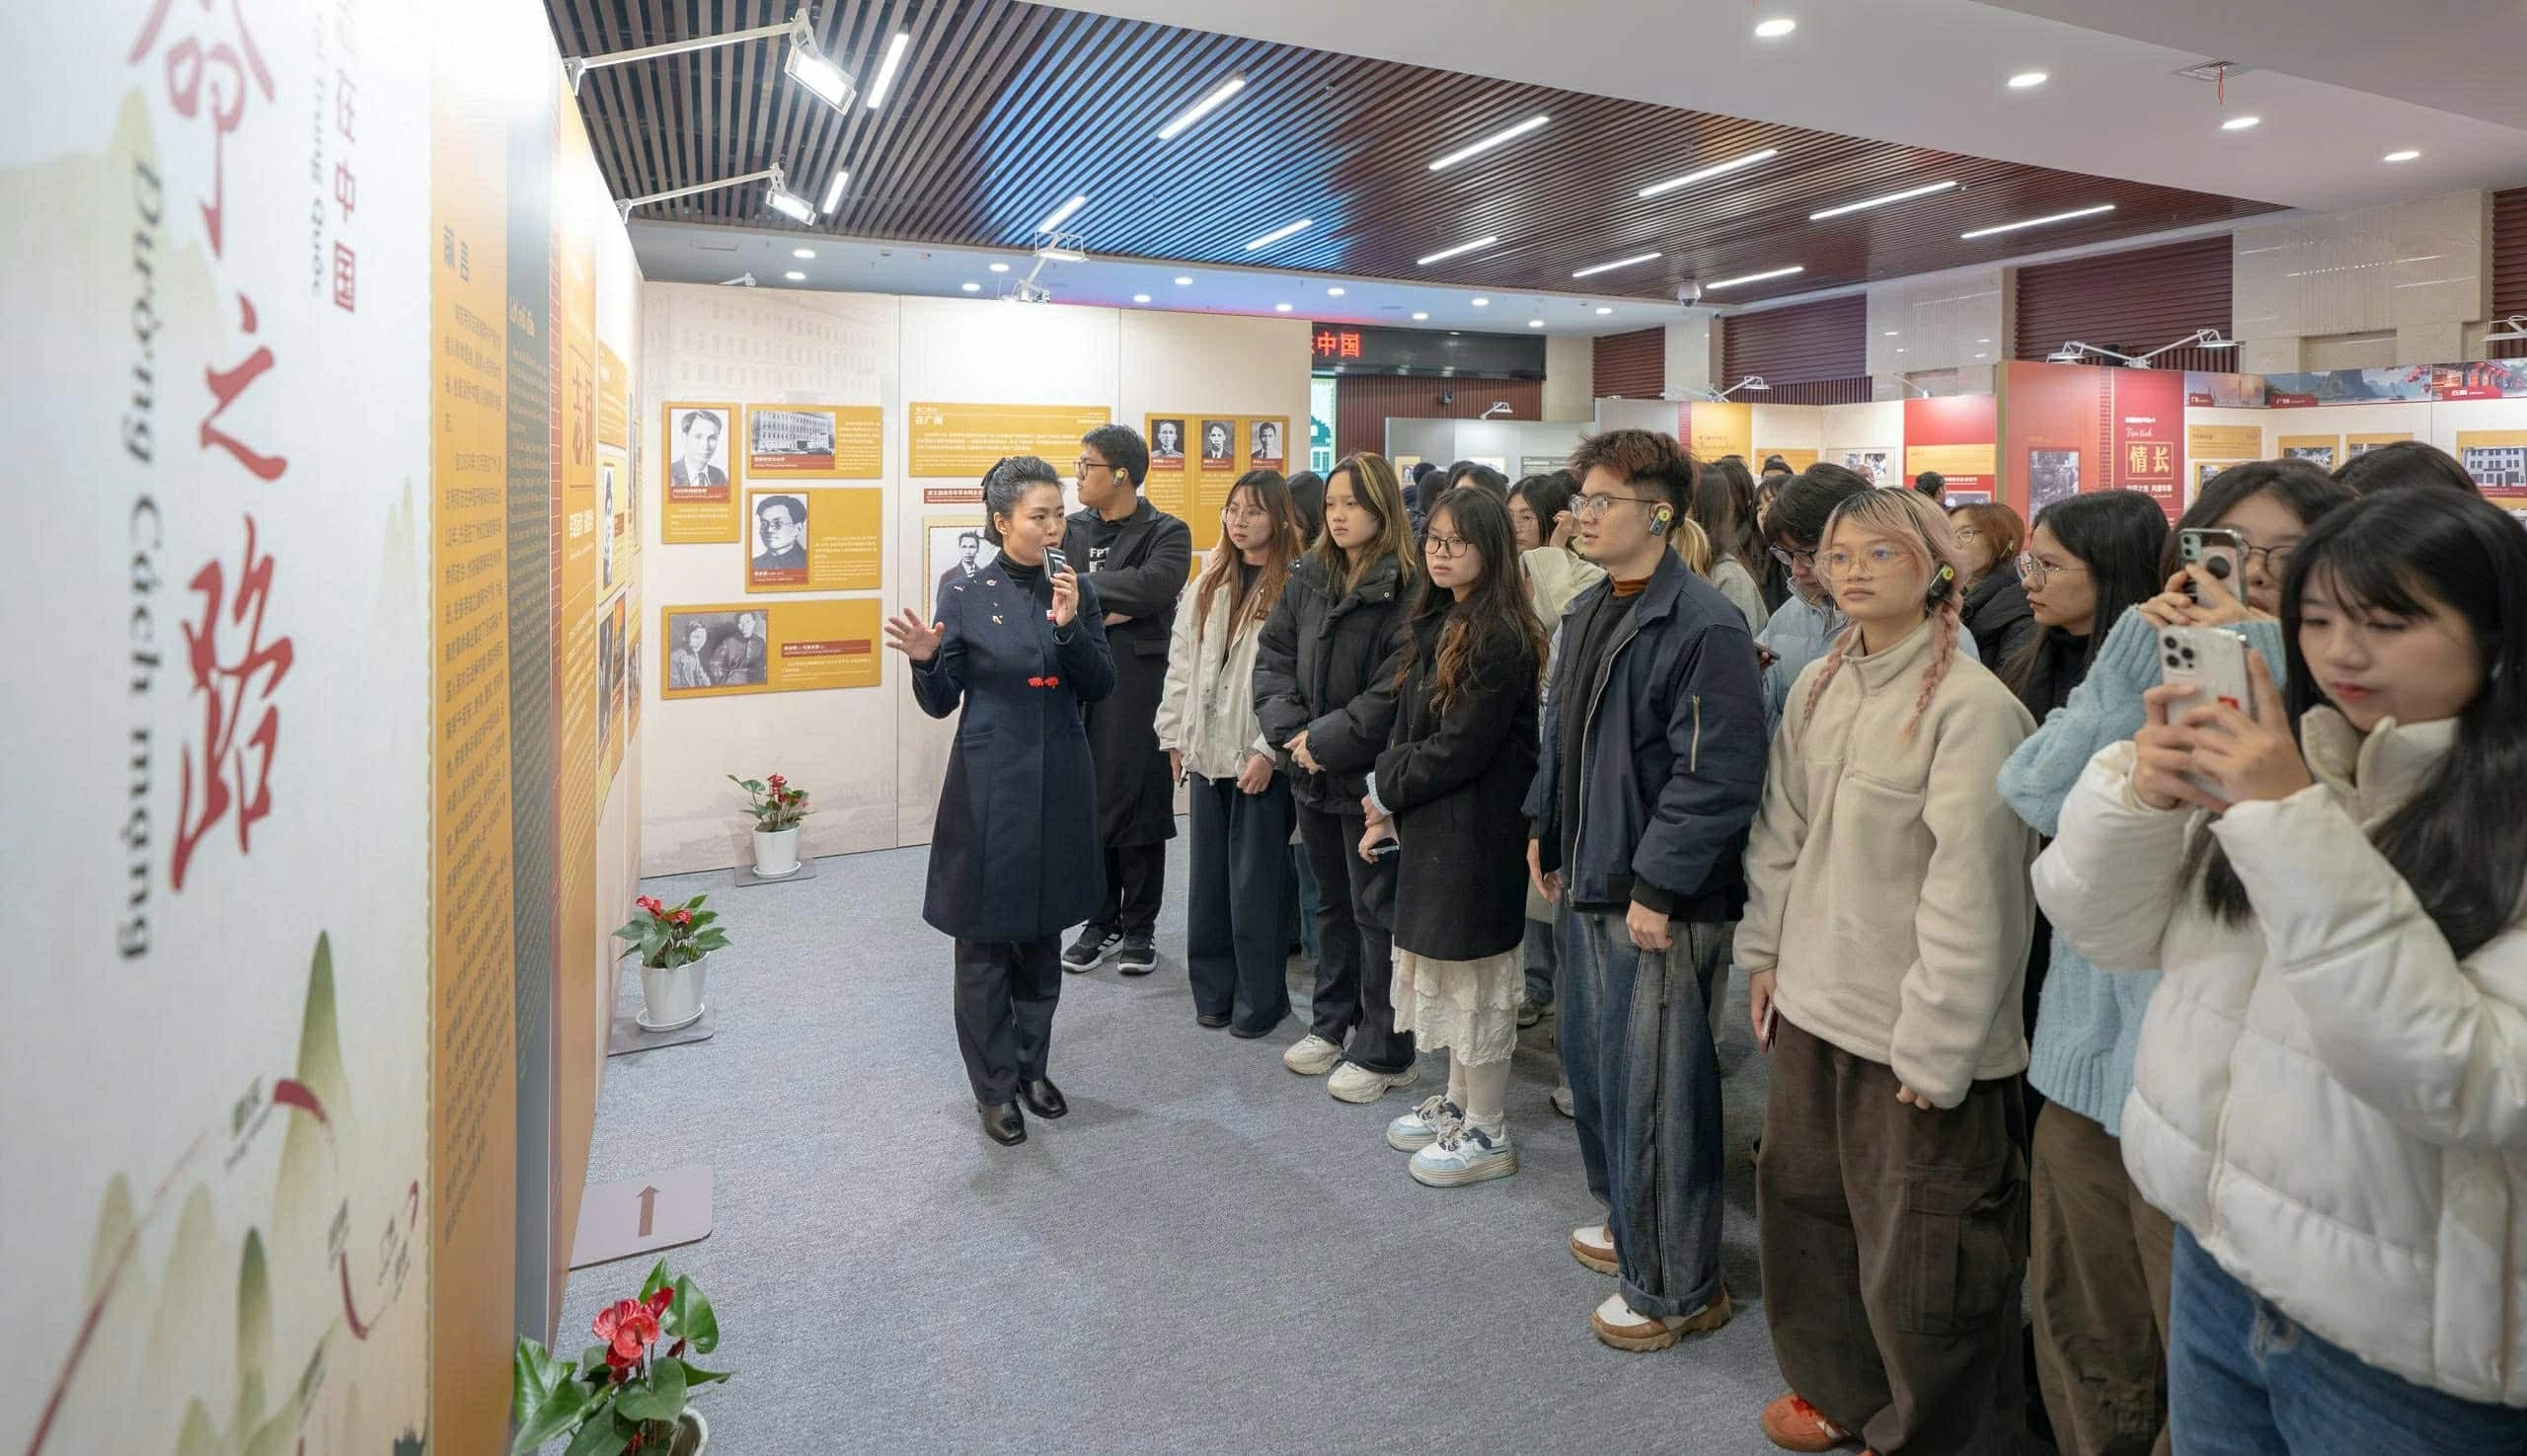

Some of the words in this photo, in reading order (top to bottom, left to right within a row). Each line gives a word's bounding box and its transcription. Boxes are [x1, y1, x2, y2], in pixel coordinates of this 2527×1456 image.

[1311, 332, 1359, 357] 中国
[2129, 446, 2170, 474] 情长
[128, 495, 162, 694] Cách
[117, 728, 151, 960] mạng
